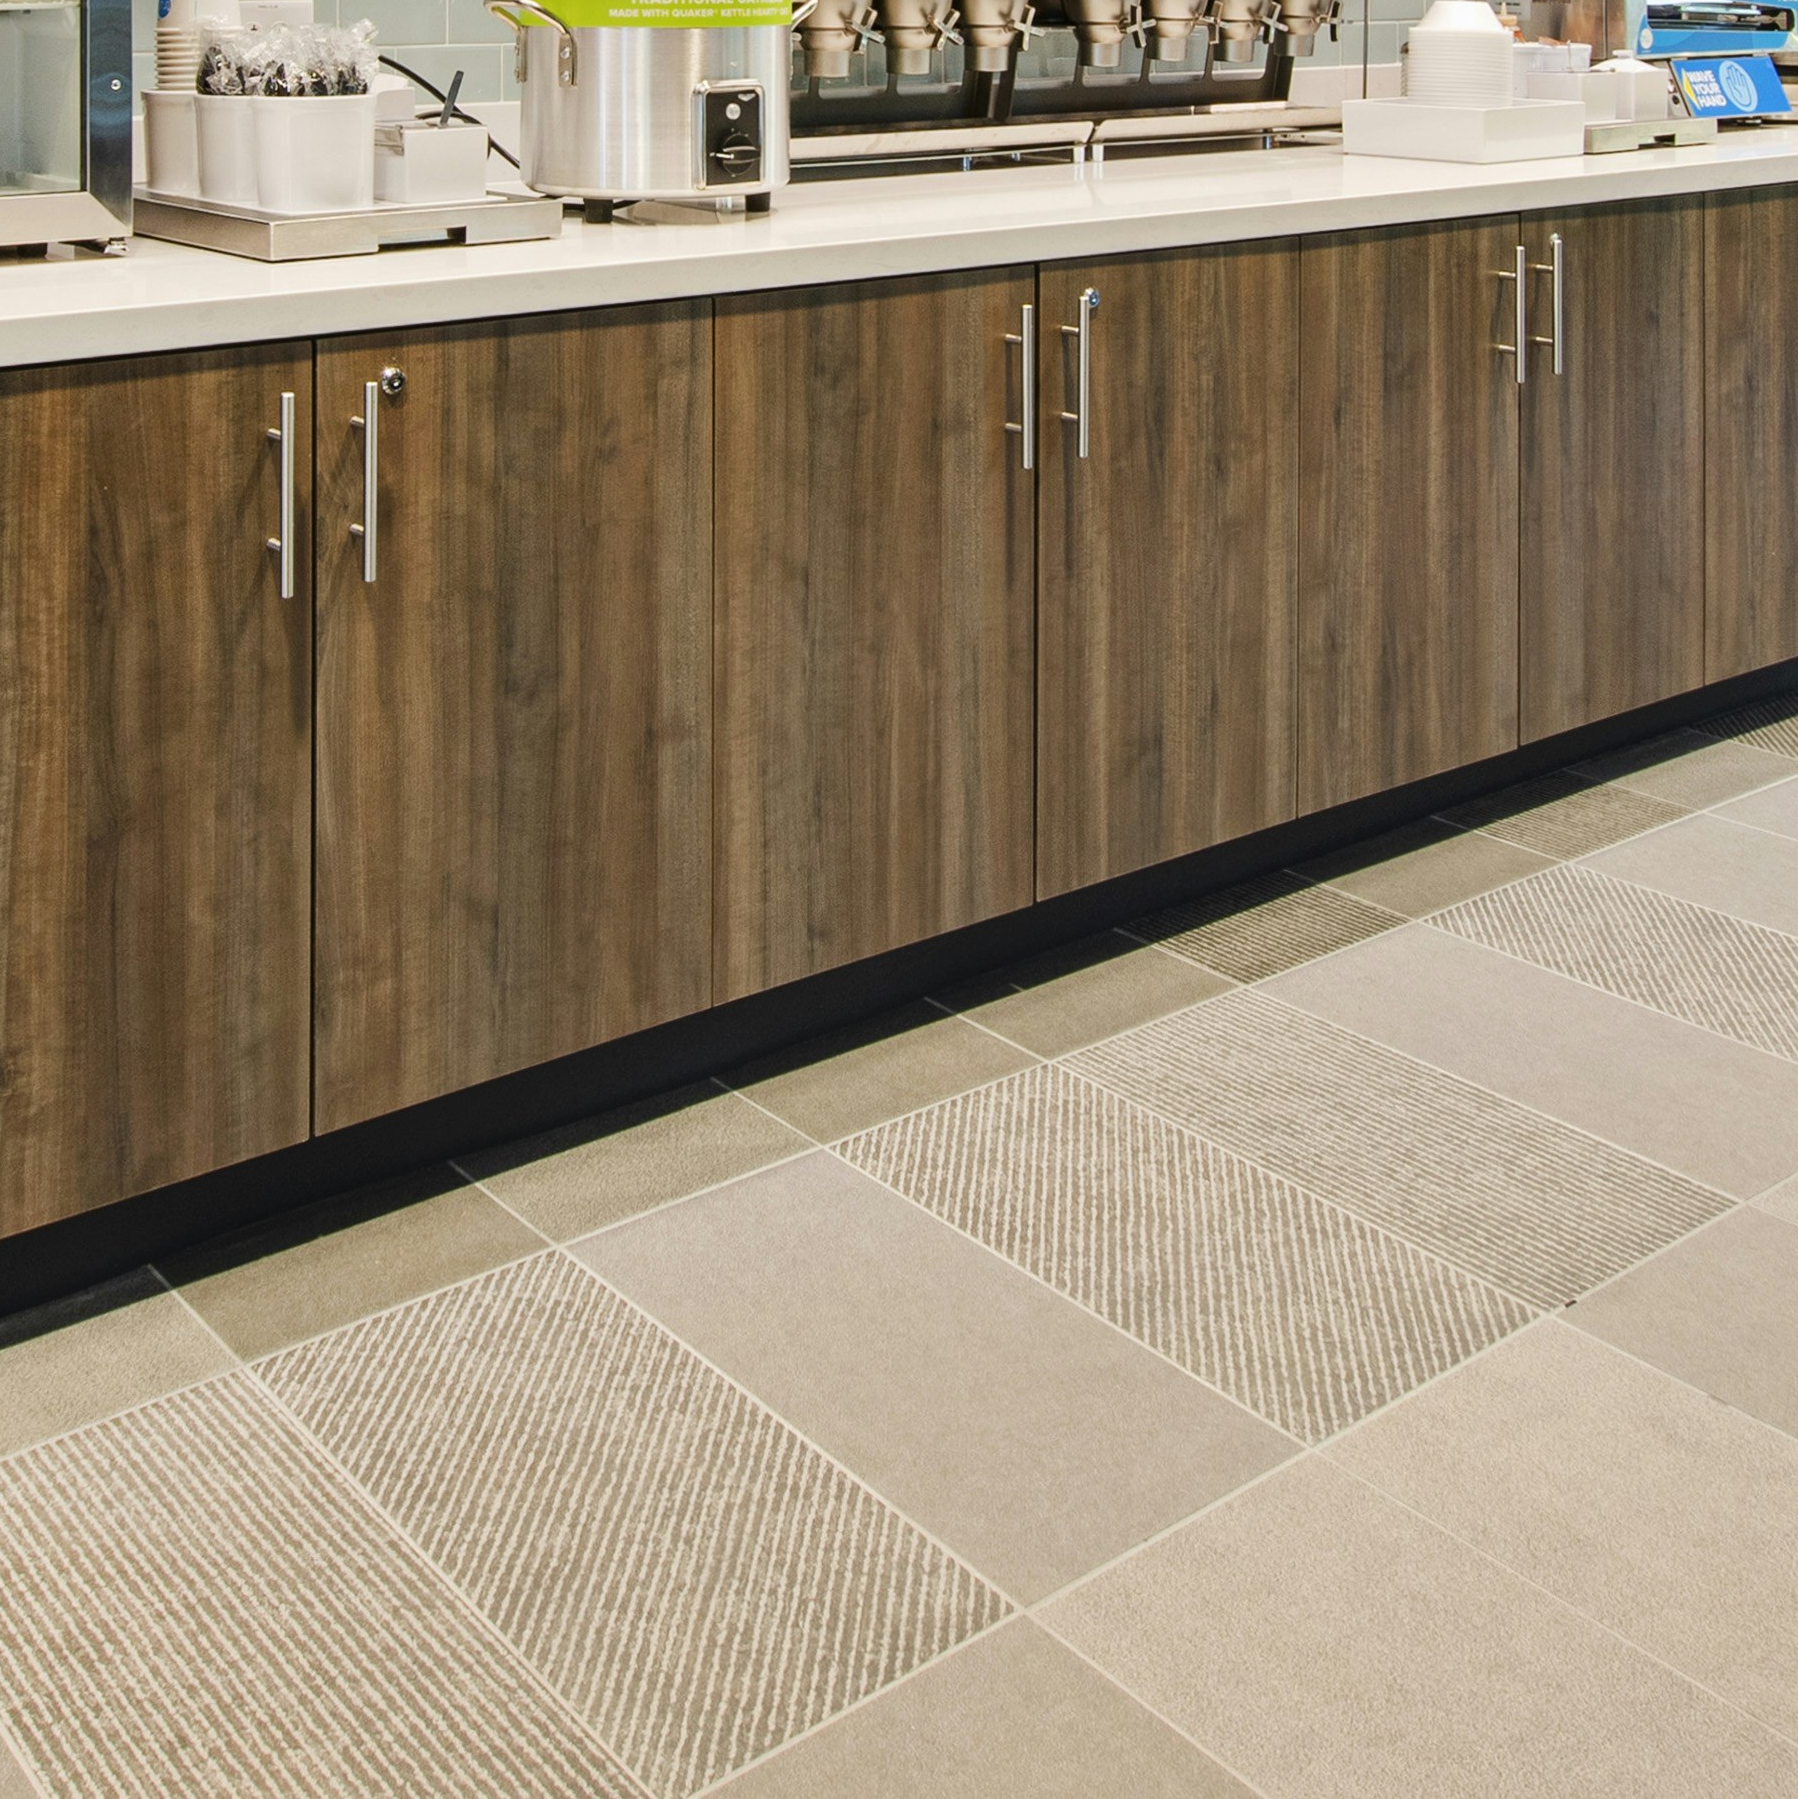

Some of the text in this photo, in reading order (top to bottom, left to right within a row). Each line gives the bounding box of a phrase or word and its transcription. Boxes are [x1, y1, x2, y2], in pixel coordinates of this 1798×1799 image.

[609, 8, 638, 18] MADE
[642, 8, 669, 18] WITH
[721, 8, 751, 17] KETTLE
[1686, 70, 1716, 82] WAVE
[1692, 82, 1722, 94] YOUR
[1697, 94, 1727, 108] HAND
